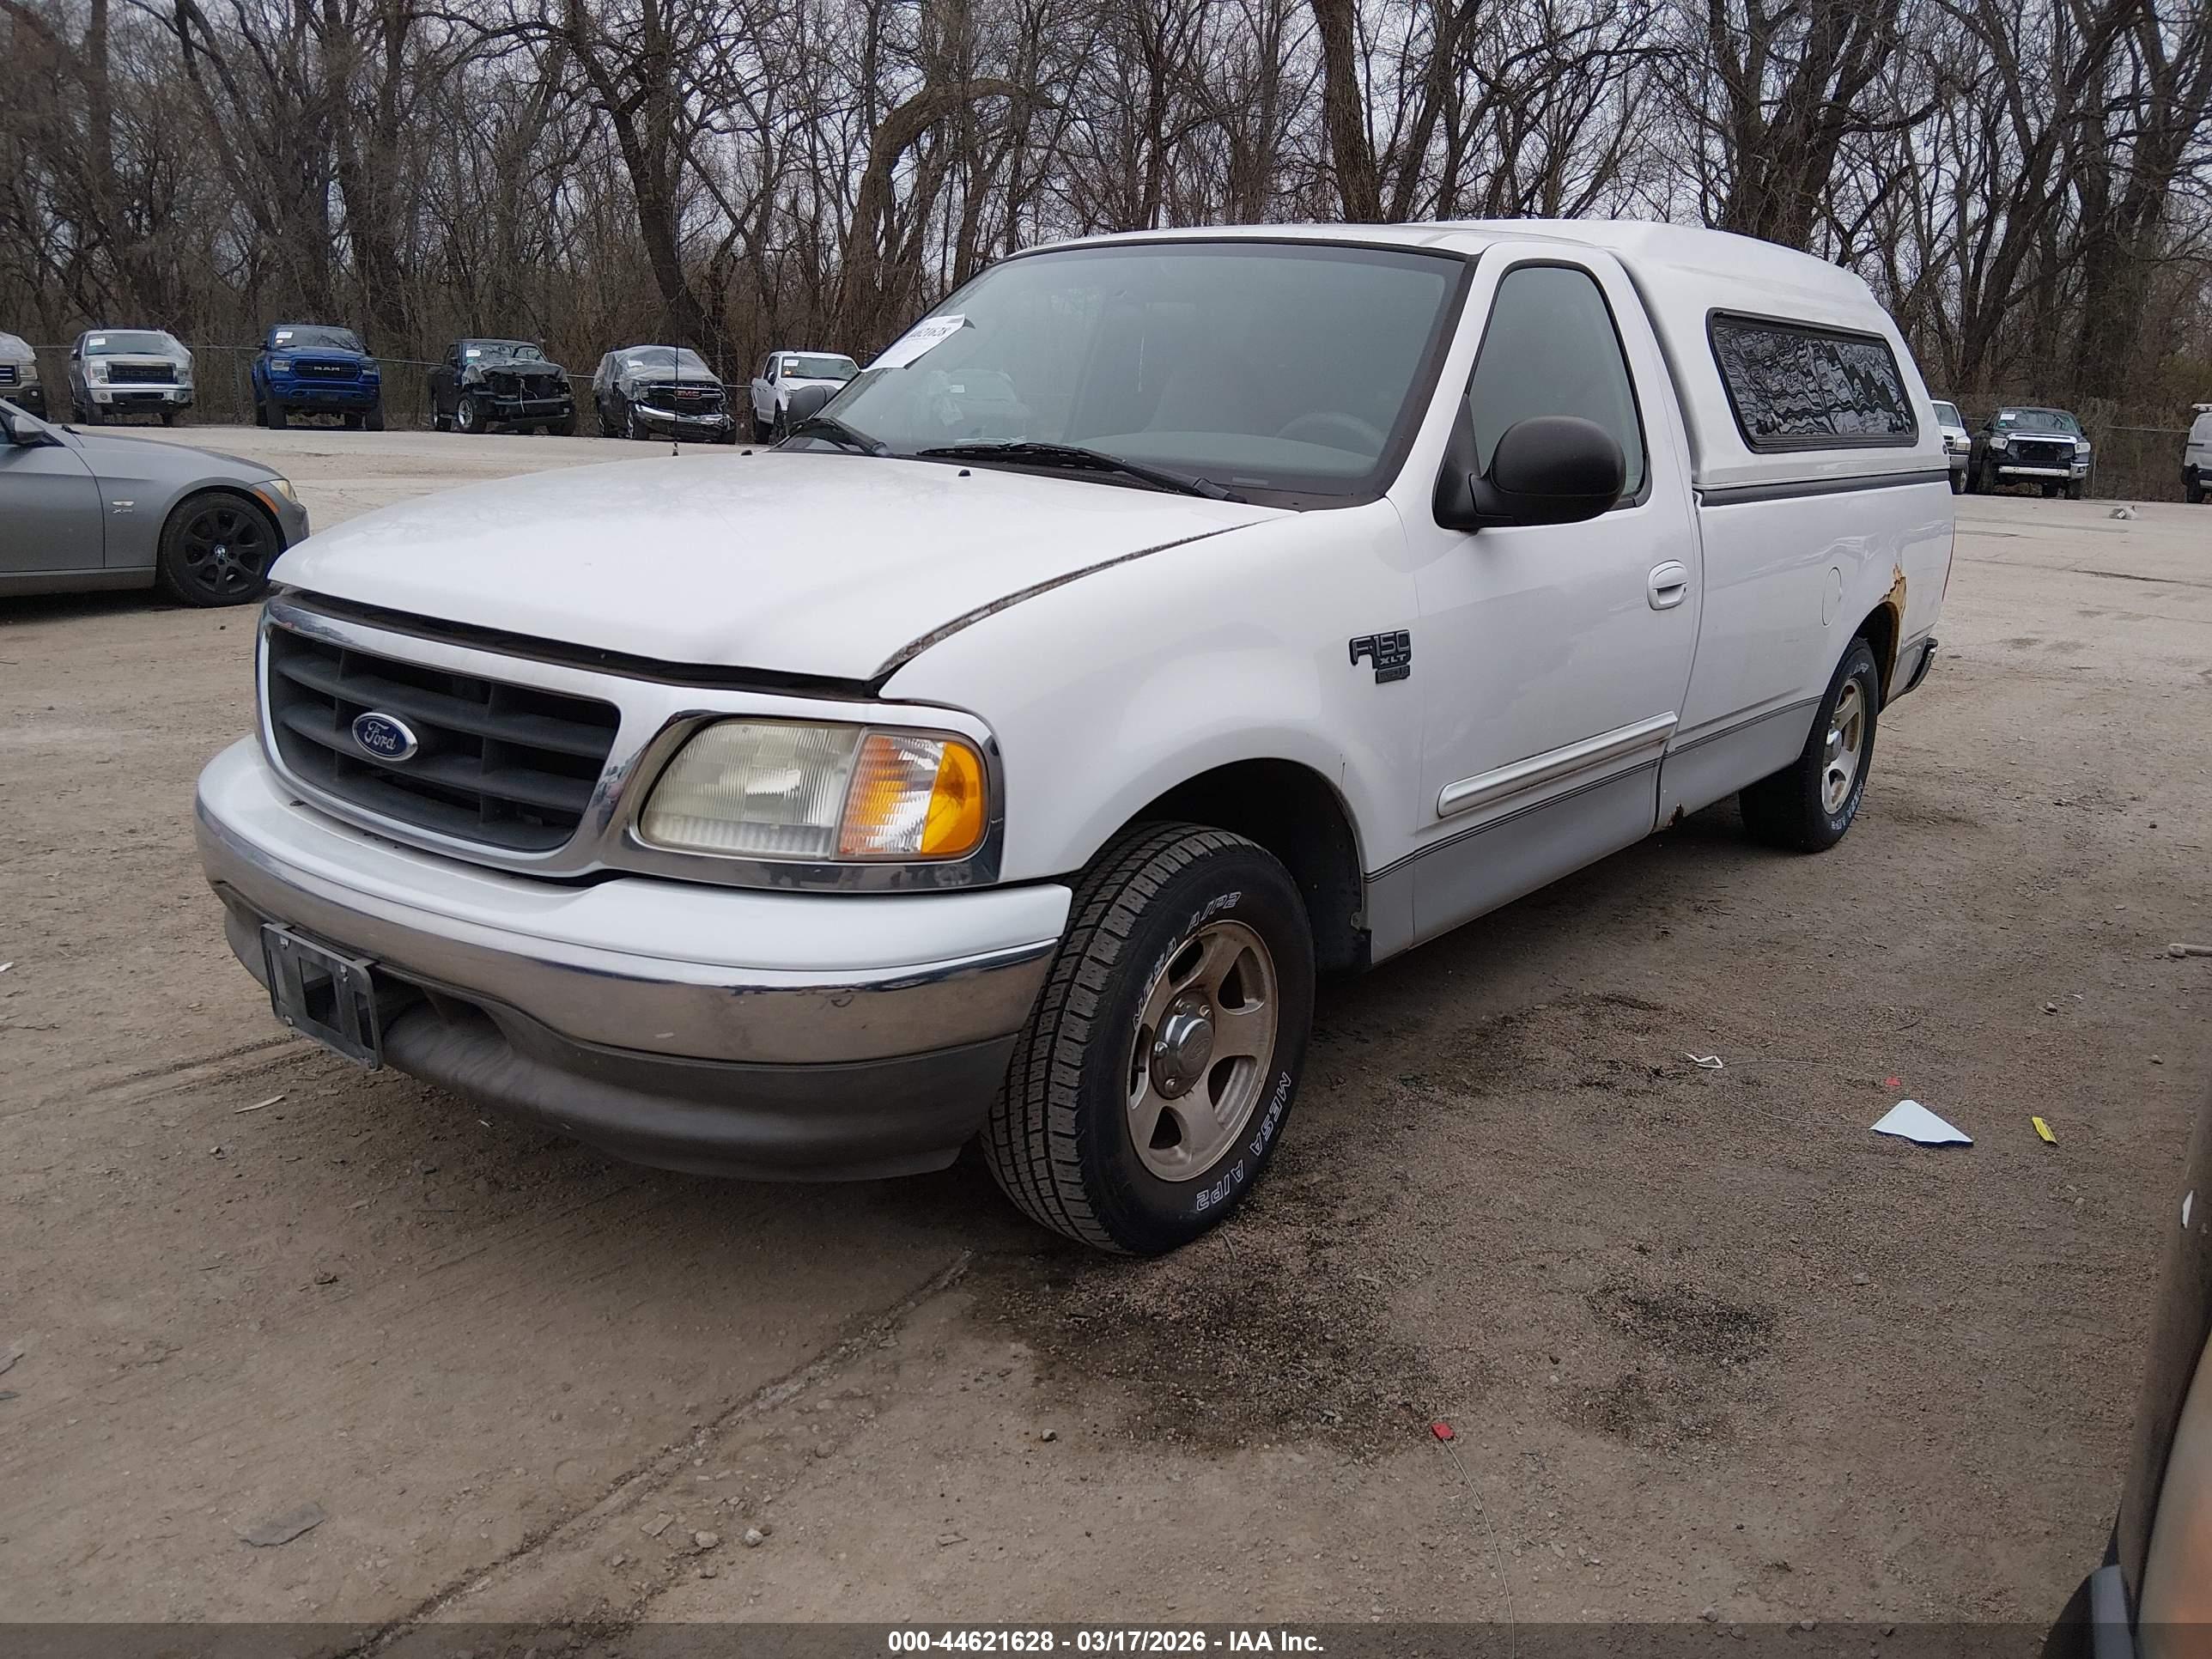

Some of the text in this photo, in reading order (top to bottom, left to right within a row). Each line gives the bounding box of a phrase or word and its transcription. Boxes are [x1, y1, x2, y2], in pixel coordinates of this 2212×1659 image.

[1352, 630, 1410, 663] F-150
[1379, 653, 1407, 665] XLT
[364, 720, 397, 750] Ford
[1249, 1071, 1292, 1156] MESA
